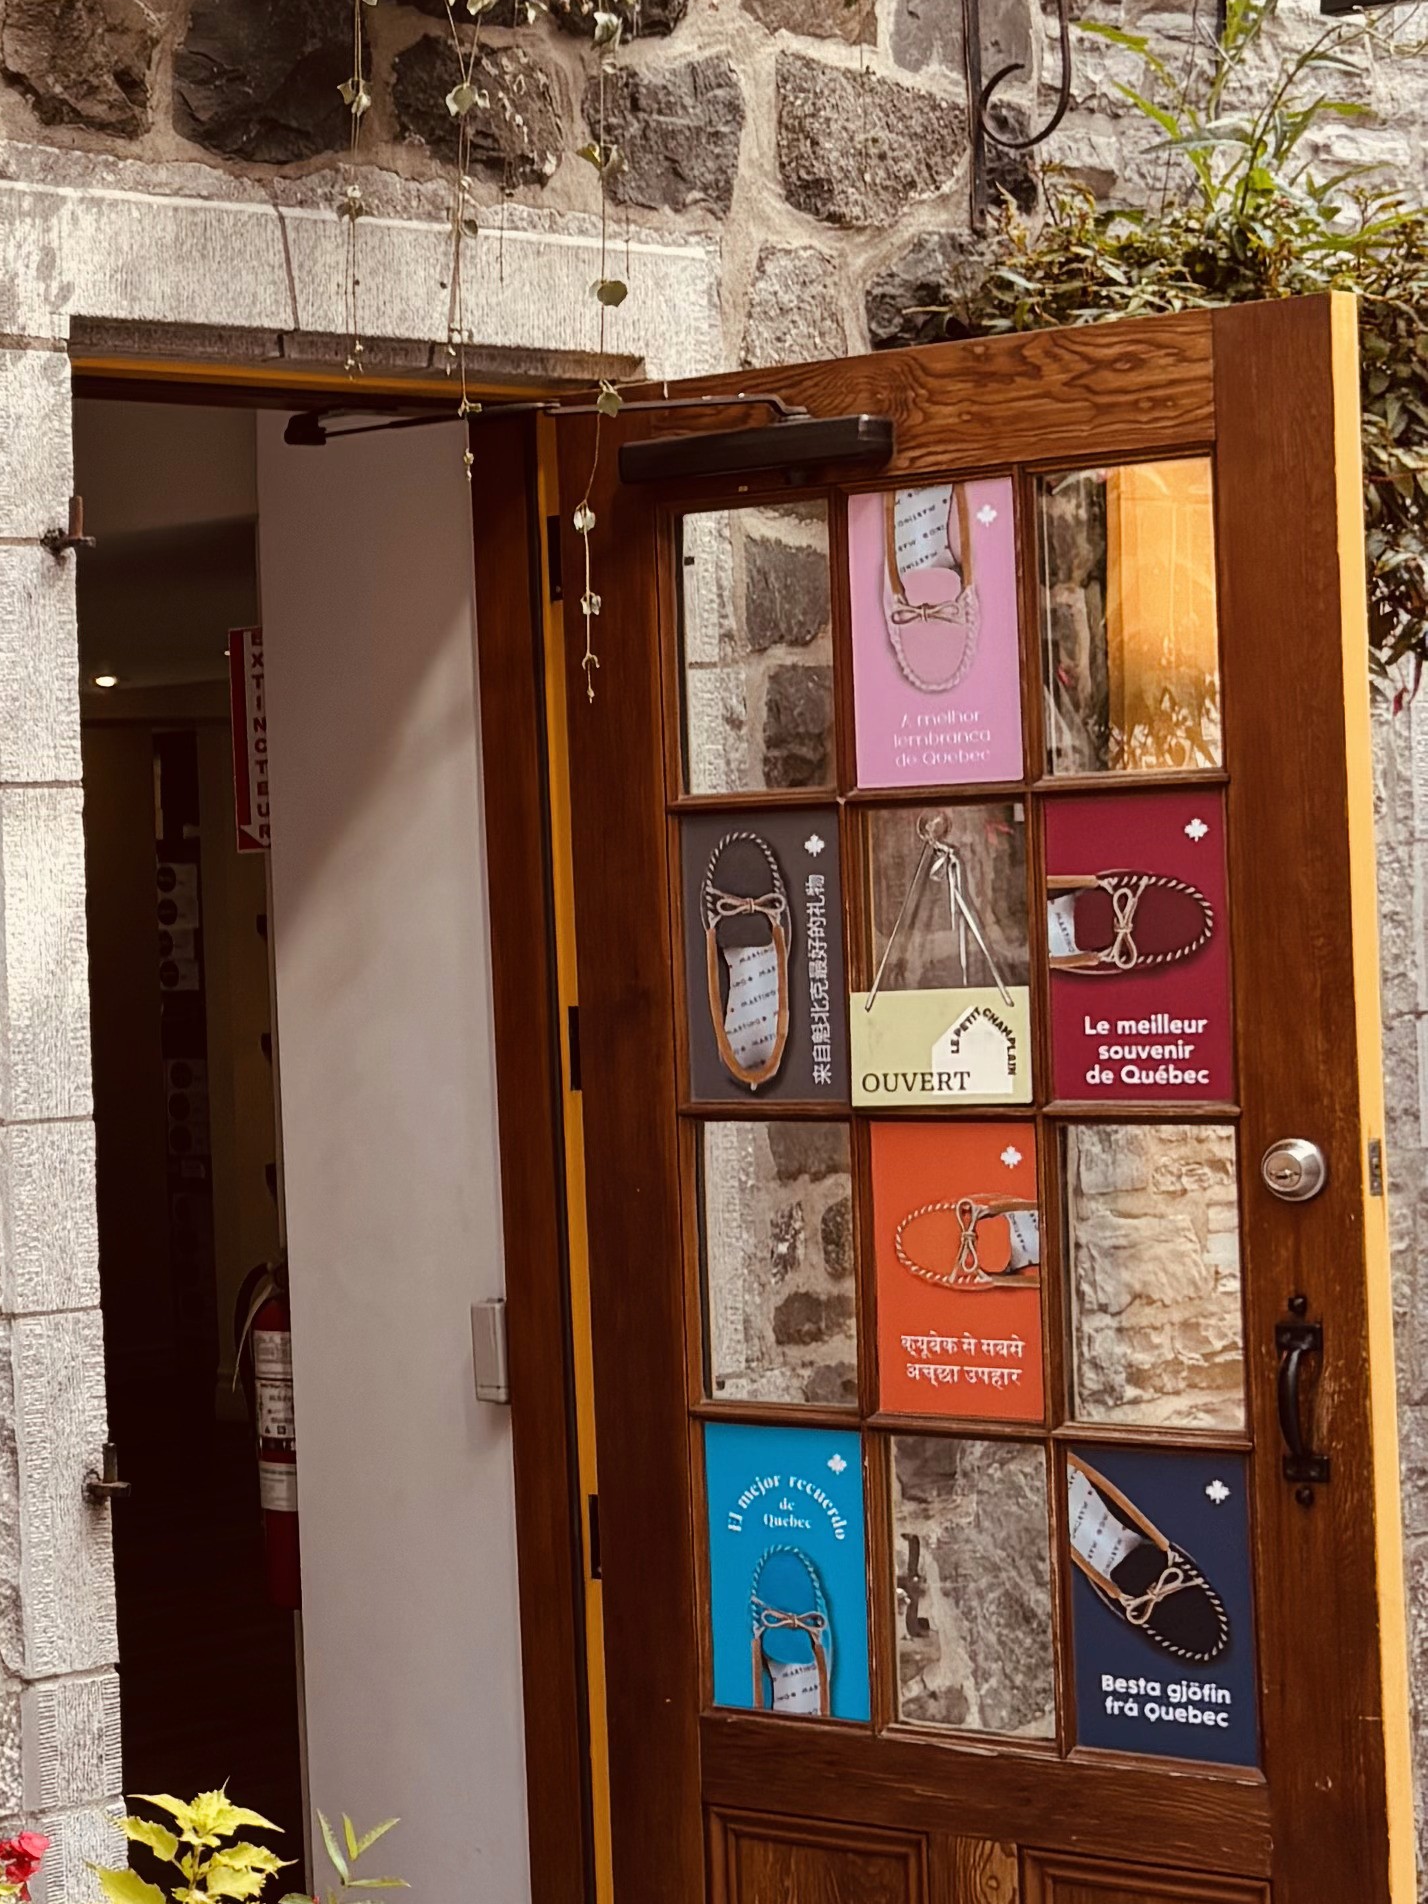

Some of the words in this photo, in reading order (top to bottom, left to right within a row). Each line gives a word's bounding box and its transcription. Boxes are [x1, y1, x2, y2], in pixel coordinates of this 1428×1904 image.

[917, 709, 979, 727] melhor
[250, 630, 271, 840] EXTINCTEUR
[895, 752, 918, 768] de
[953, 1006, 981, 1038] PETIT
[1084, 1015, 1111, 1035] Le
[1117, 1013, 1208, 1035] meilleur
[950, 1039, 960, 1054] LE
[982, 1007, 1017, 1076] CHAMPLAIN
[1098, 1039, 1195, 1060] souvenir
[862, 1071, 971, 1093] OUVERT
[1086, 1063, 1115, 1085] de
[1120, 1063, 1210, 1085] Québec
[961, 1332, 978, 1356] से
[981, 1334, 1026, 1358] सबसे
[964, 1366, 1023, 1391] उपहार
[728, 1511, 743, 1532] El
[738, 1475, 781, 1509] mejor
[789, 1476, 847, 1540] recuerdo
[779, 1497, 795, 1511] de
[763, 1513, 811, 1528] Quebec
[1101, 1674, 1162, 1697] Besta
[1167, 1680, 1232, 1704] gjöfin
[1105, 1696, 1139, 1717] frá
[1144, 1702, 1229, 1728] Quebec
